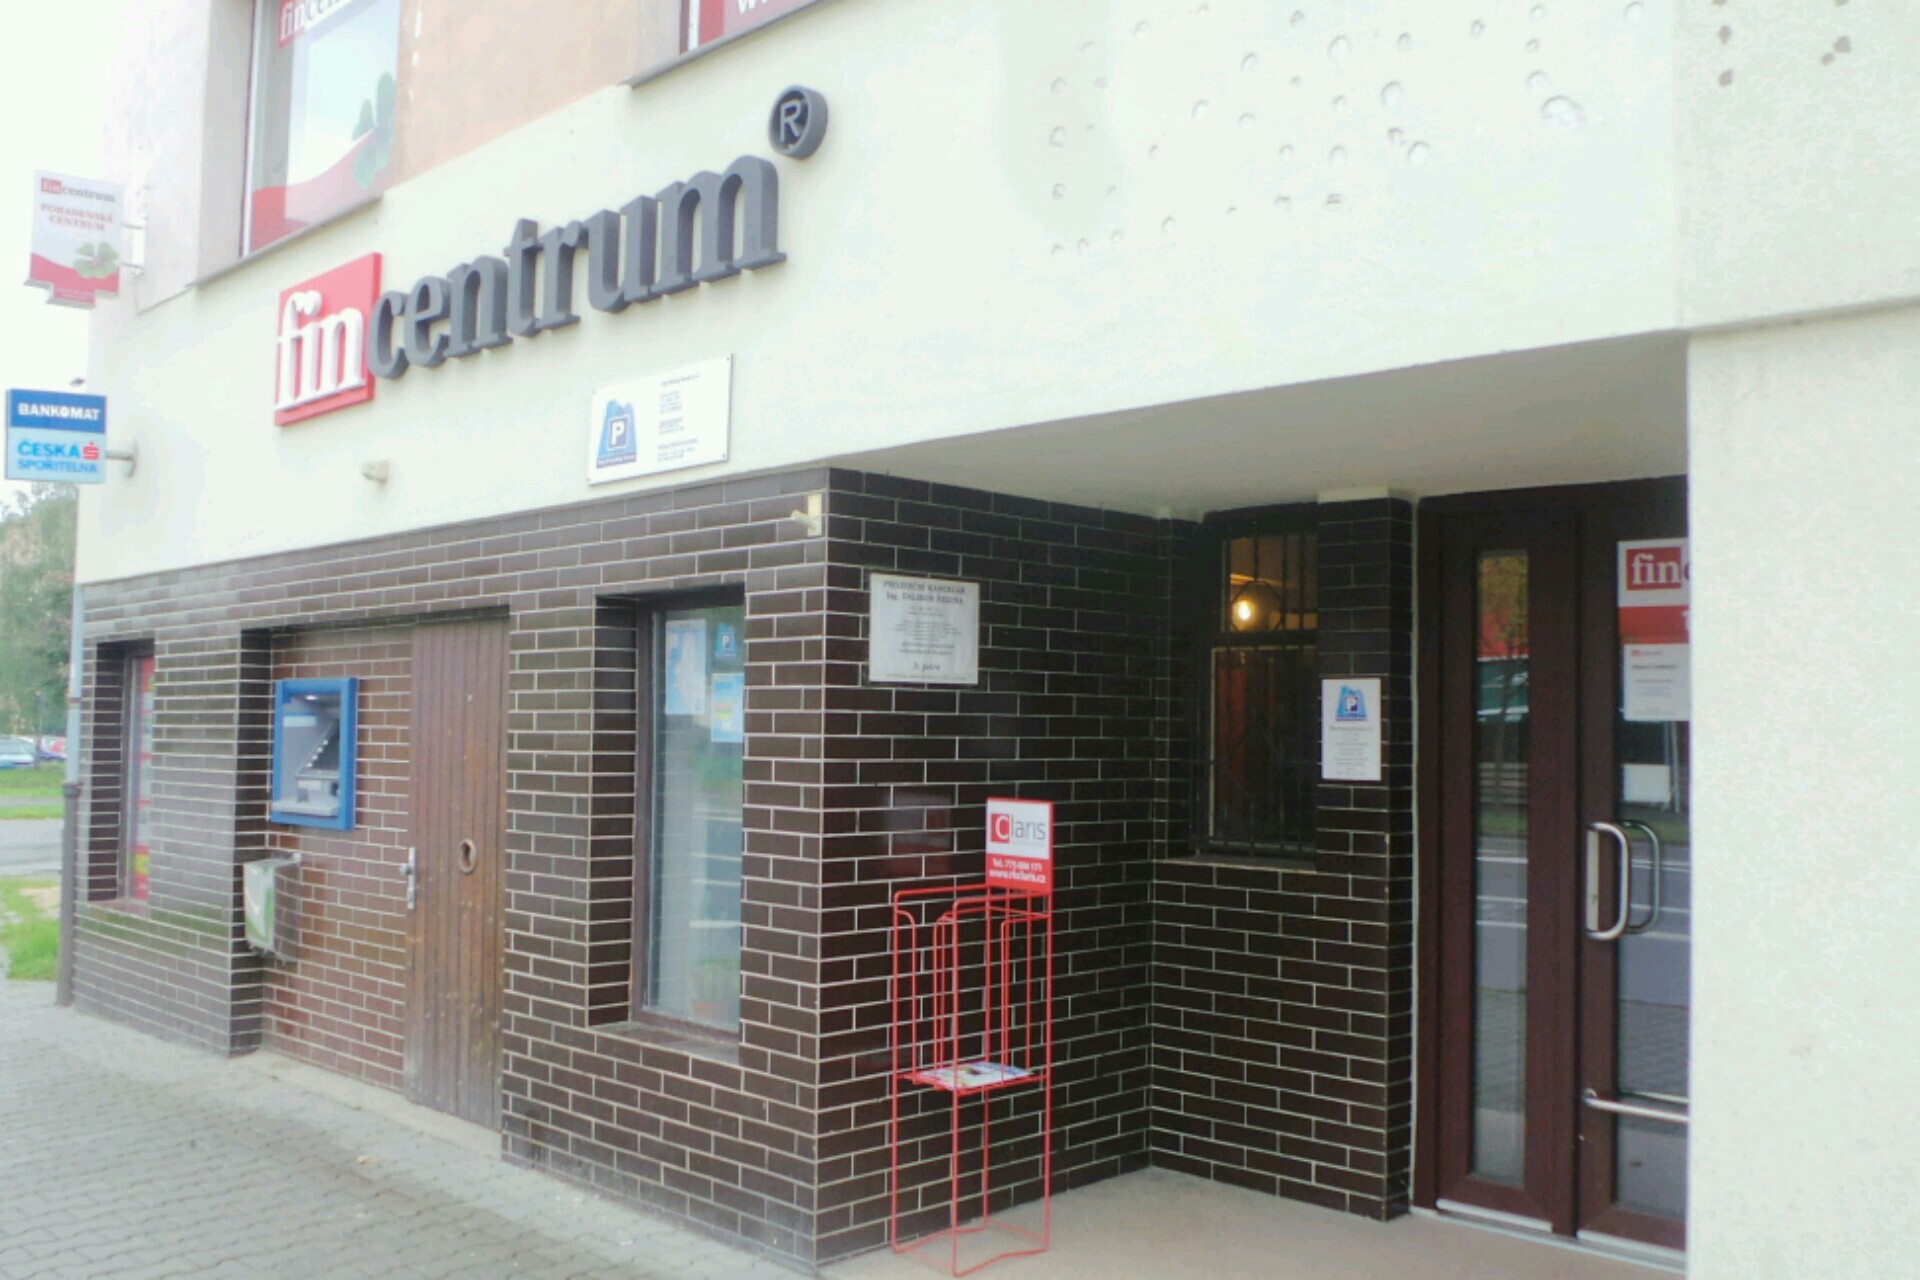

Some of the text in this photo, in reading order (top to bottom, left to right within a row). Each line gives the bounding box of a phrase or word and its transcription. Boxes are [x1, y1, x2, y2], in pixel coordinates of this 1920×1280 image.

[42, 178, 116, 202] fincentrum
[48, 214, 106, 231] CENTRUM
[18, 402, 100, 420] BANKOMAT
